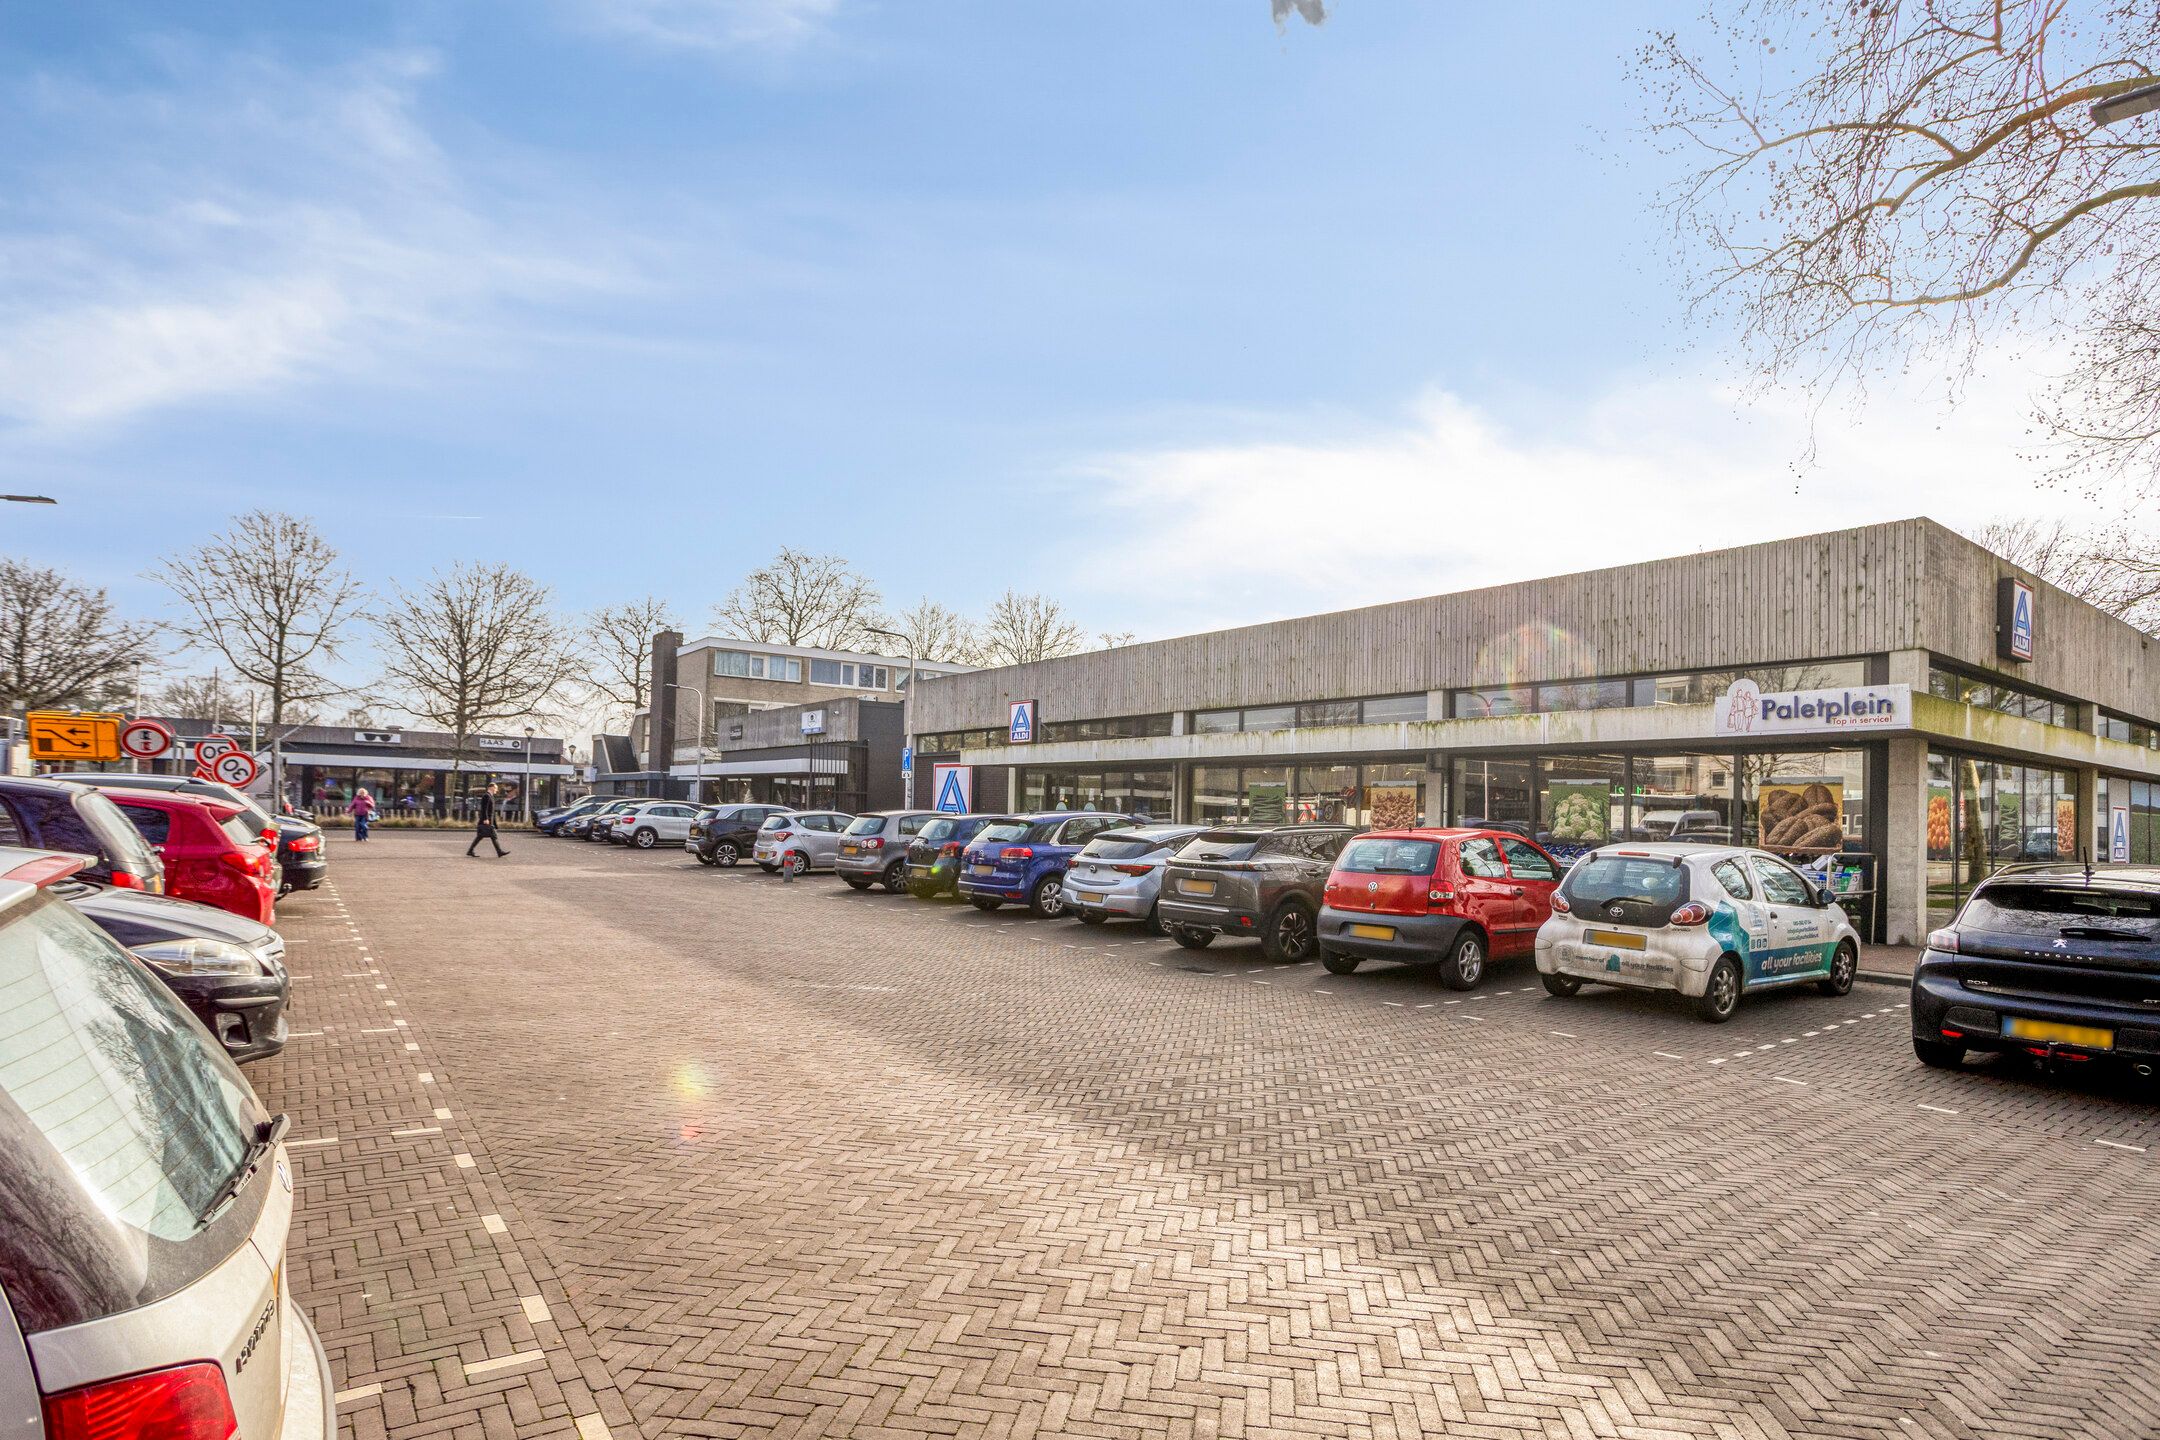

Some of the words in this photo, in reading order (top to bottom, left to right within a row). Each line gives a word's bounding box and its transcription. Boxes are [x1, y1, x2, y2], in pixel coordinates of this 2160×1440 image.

[2014, 634, 2029, 651] ALDI
[1761, 692, 1894, 724] Paletplein
[1832, 717, 1847, 726] Top
[1849, 716, 1857, 724] in
[1859, 715, 1893, 724] service!
[1013, 732, 1029, 740] ALDI
[223, 759, 249, 781] 30
[1761, 956, 1773, 971] all
[1773, 955, 1792, 973] your
[1792, 950, 1823, 967] facilities
